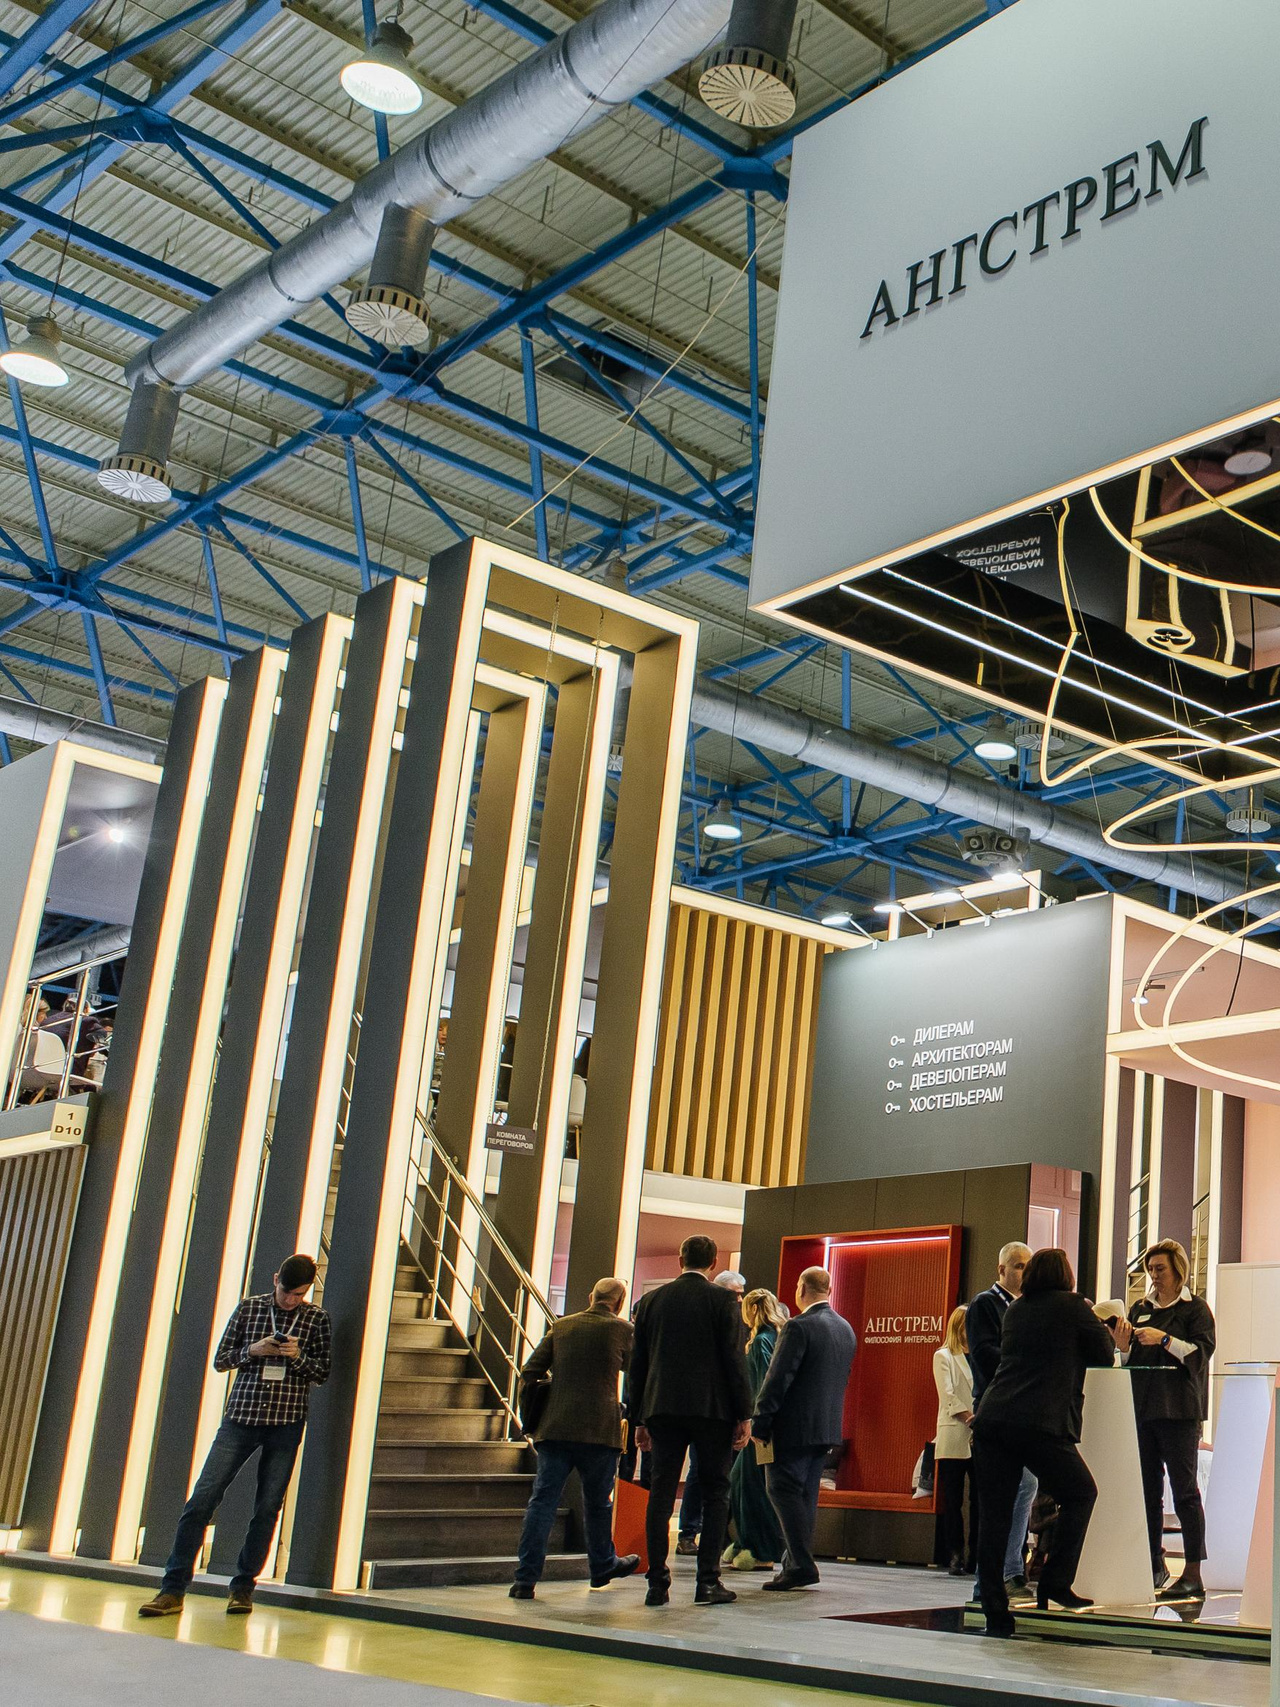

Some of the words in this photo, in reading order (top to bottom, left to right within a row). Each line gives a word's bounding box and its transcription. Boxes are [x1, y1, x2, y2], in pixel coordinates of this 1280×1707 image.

[859, 115, 1208, 339] АНГСТРЕМ
[913, 1020, 974, 1046] ДИЛЕРАМ
[911, 1038, 1013, 1067] АРХИТЕКТОРАМ
[909, 1061, 1007, 1091] ДЕВЕЛОПЕРАМ
[908, 1086, 1003, 1113] ХОСТЕЛЬЕРАМ
[67, 1112, 74, 1120] 1
[54, 1125, 82, 1136] D10
[496, 1131, 526, 1141] КОМНАТА
[487, 1137, 534, 1150] ПЕРЕГОВОРОВ
[865, 1315, 943, 1333] АНГСТРЕМ
[864, 1336, 901, 1344] ФИЛОСОФИЯ
[904, 1335, 940, 1344] ИНТЕРЬЕРА
